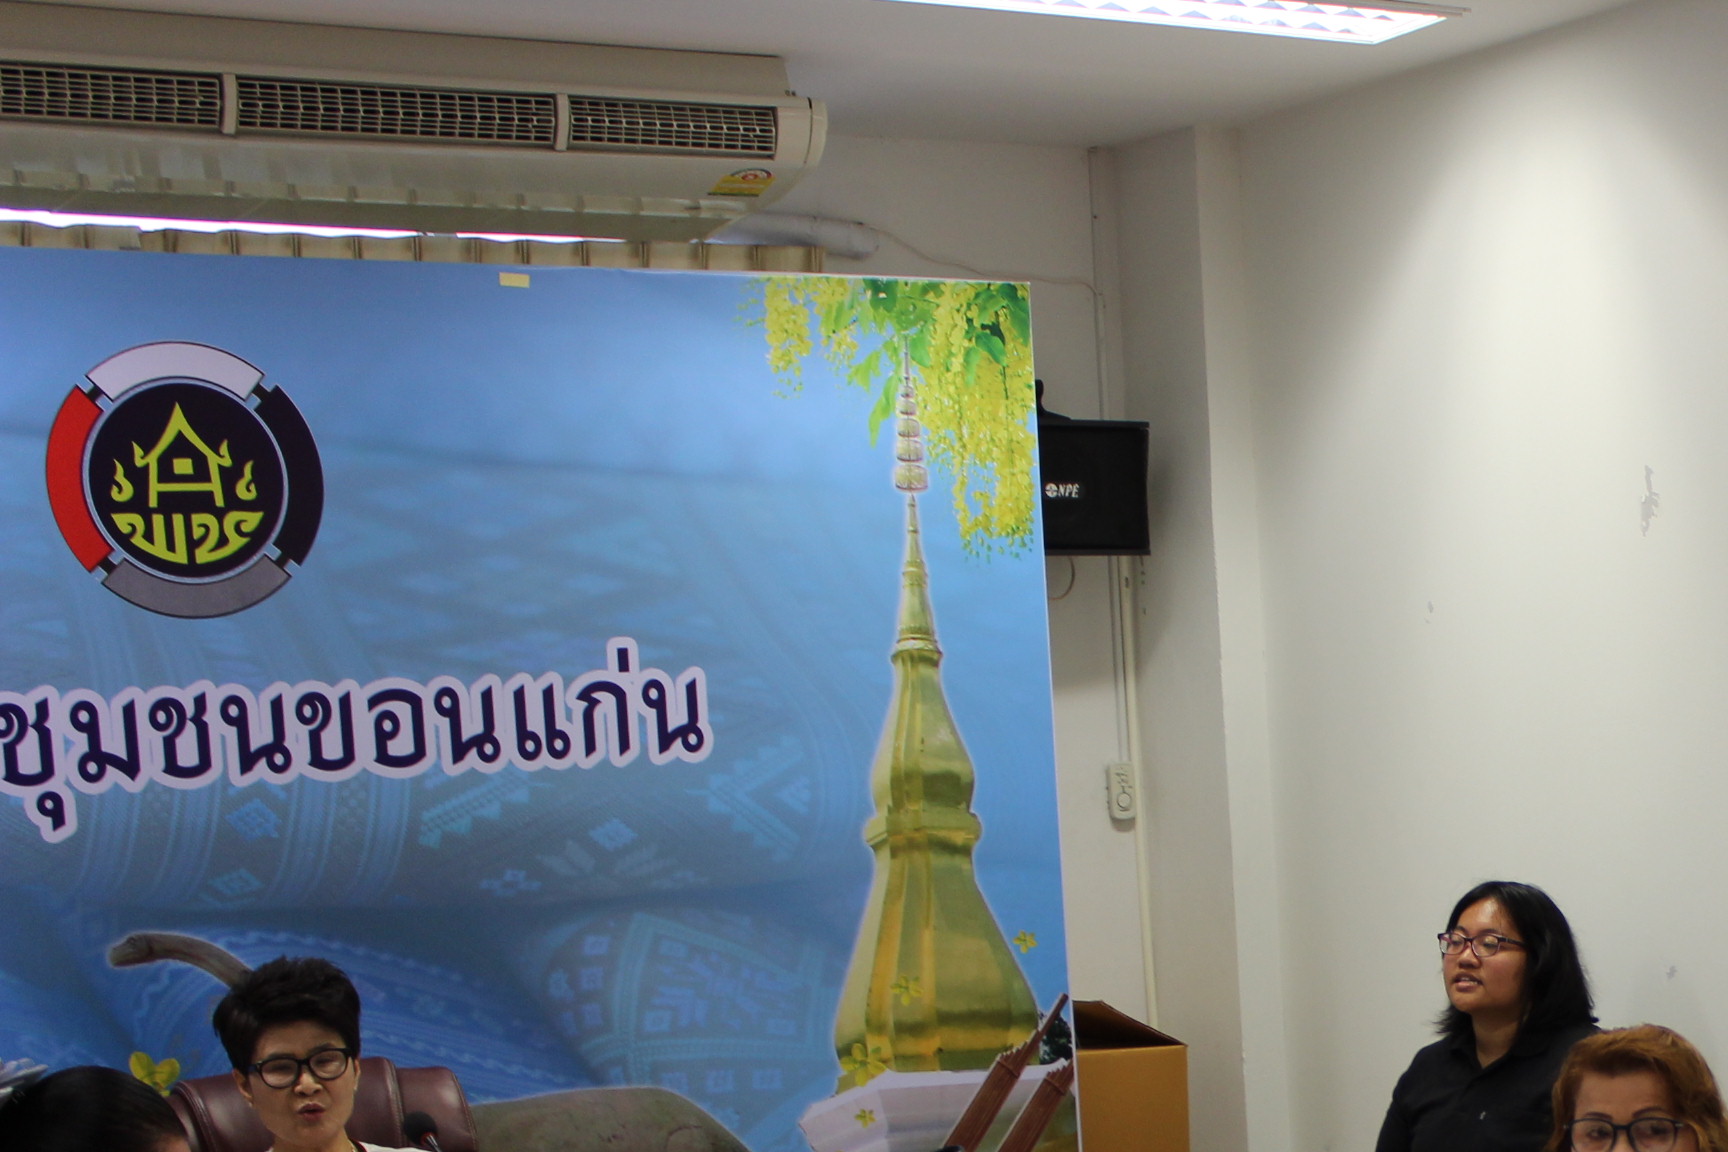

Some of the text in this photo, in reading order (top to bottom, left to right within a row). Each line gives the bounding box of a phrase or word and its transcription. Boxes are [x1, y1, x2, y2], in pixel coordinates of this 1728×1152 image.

[0, 645, 706, 833] ชุมชนขอนแก่น
